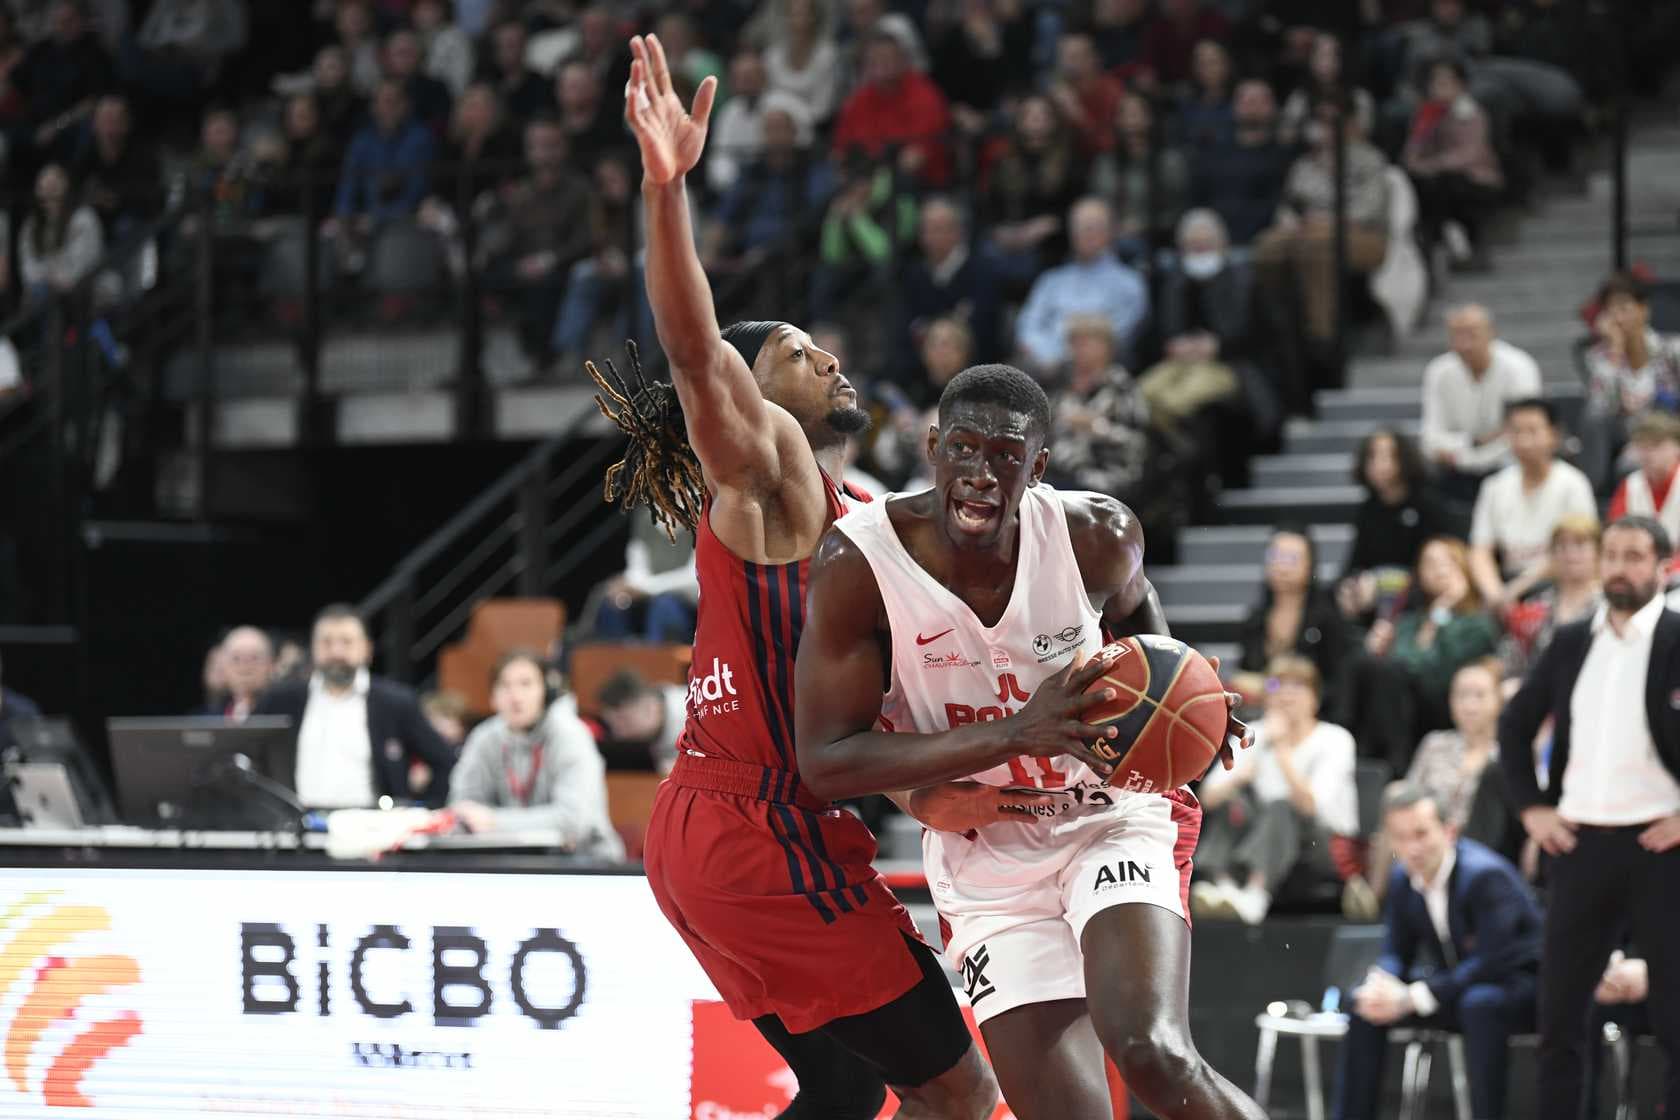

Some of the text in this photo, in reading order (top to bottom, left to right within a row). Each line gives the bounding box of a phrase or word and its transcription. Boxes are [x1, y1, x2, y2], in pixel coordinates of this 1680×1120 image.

[923, 653, 944, 664] Sun
[1094, 861, 1151, 891] AIN
[241, 921, 588, 1030] BiCBO
